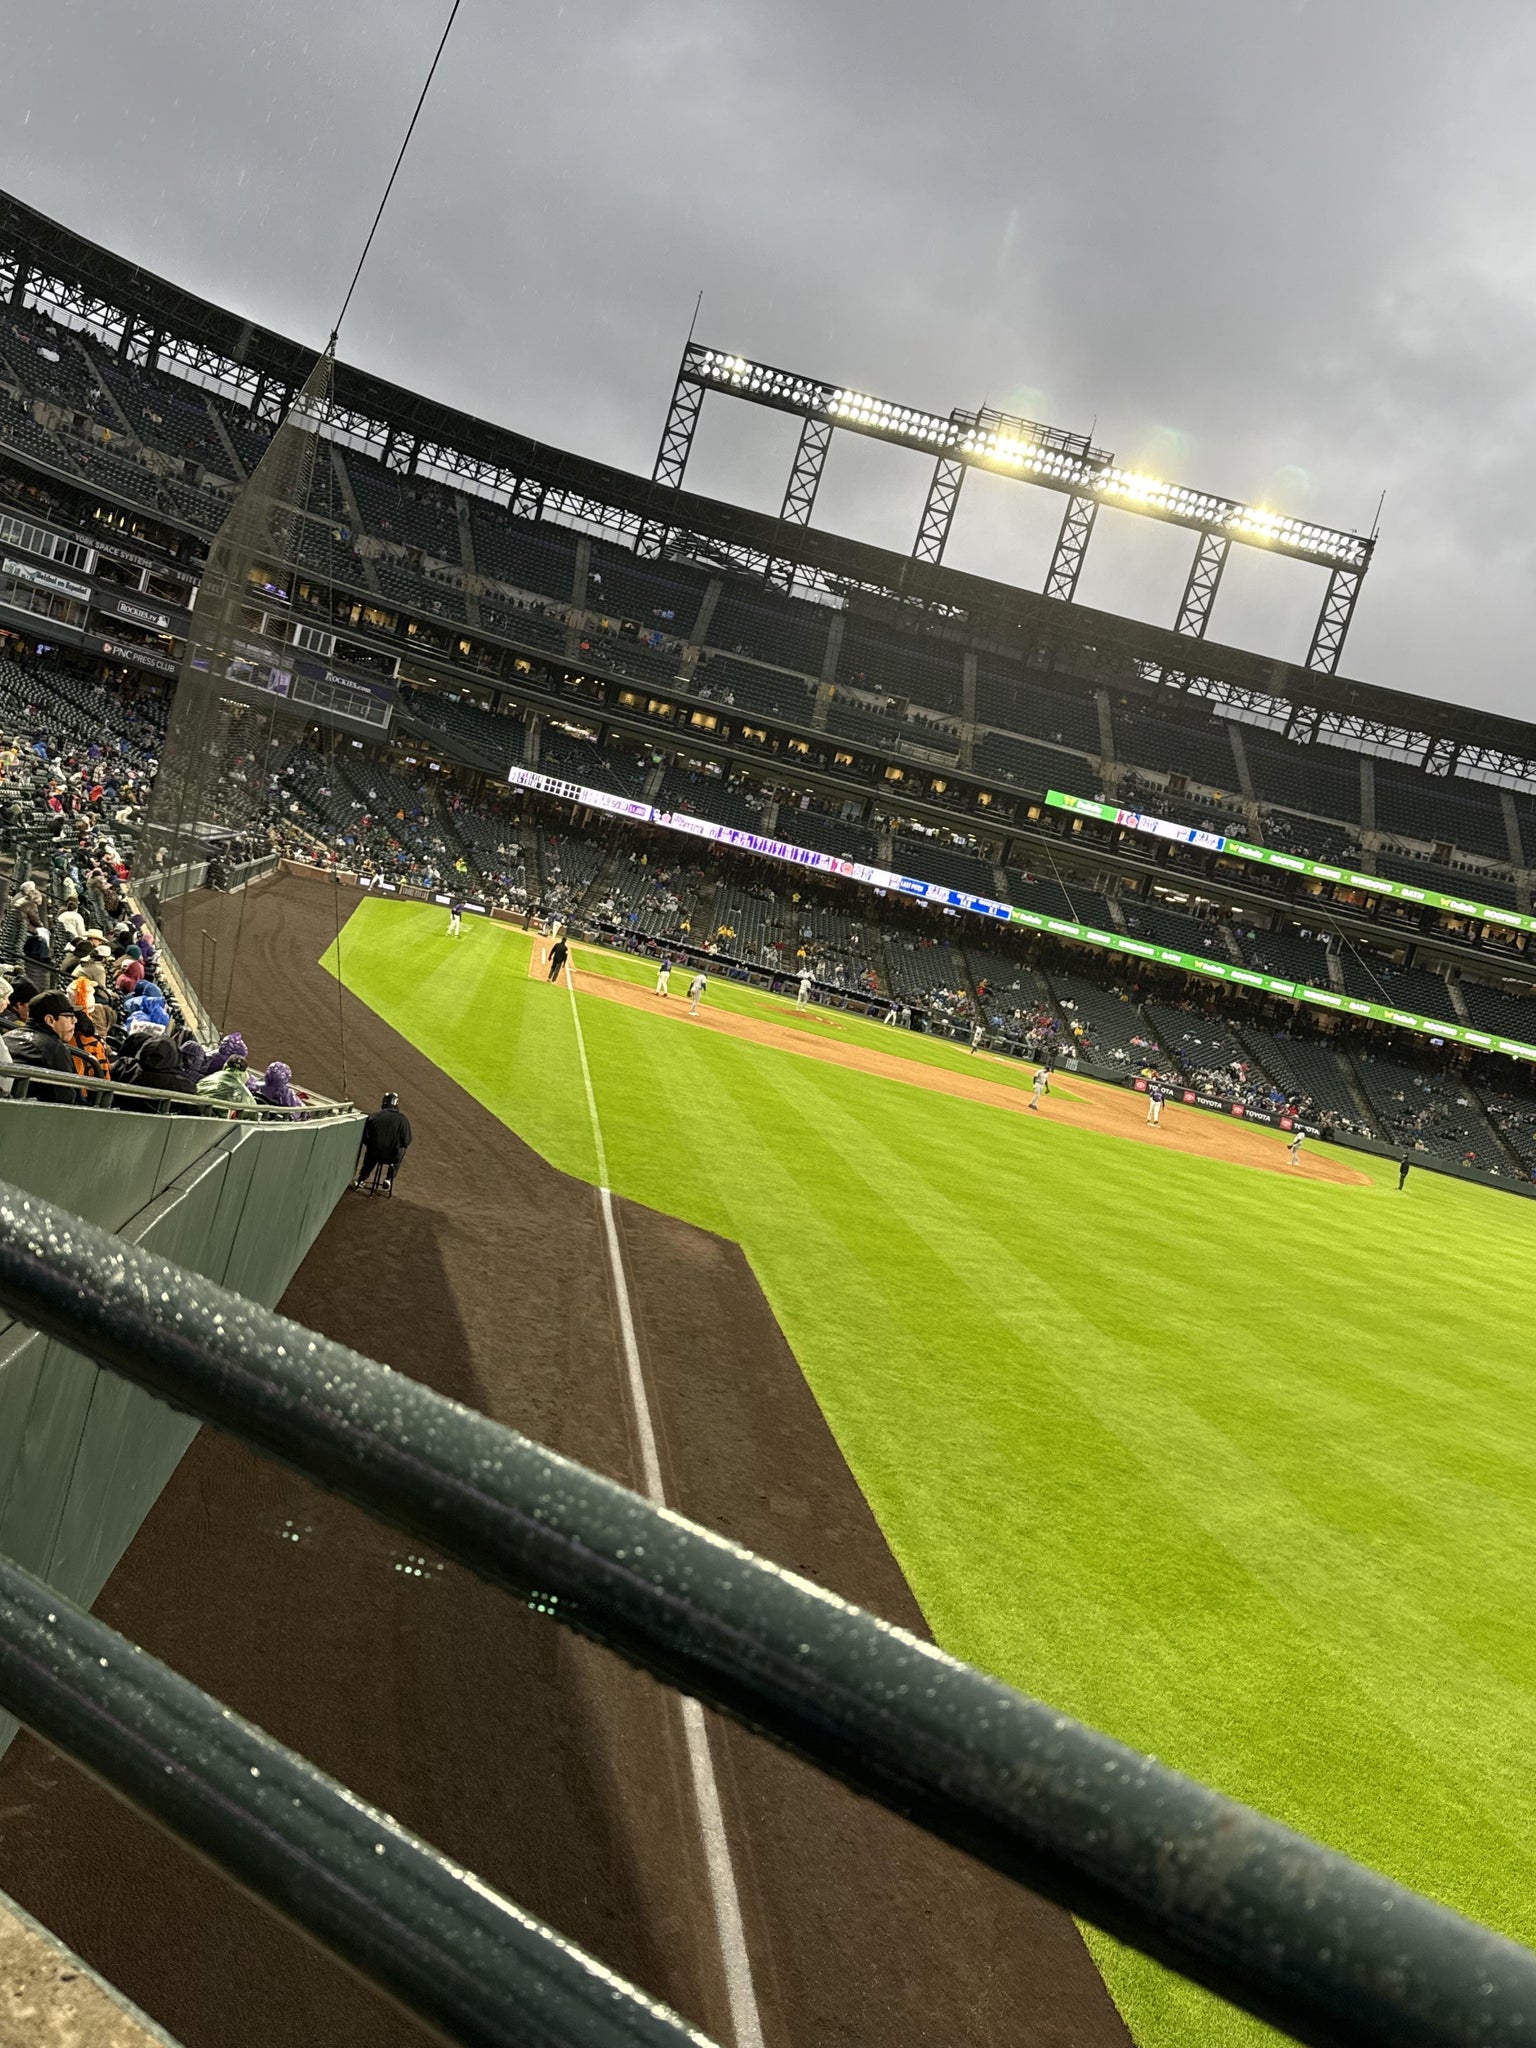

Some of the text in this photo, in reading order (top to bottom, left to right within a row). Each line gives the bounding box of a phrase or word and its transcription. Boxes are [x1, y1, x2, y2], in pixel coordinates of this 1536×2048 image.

[74, 532, 153, 569] YORK SPACE SYSTEMS
[176, 572, 197, 586] SUITE
[113, 645, 176, 673] PNC PRESS CLUB
[1269, 854, 1305, 870] ROOFING
[1313, 866, 1342, 880] SIDING
[1350, 875, 1393, 892] WINDOWS
[1401, 888, 1425, 901] BATH
[1483, 909, 1521, 925] ROOFING
[1047, 920, 1079, 935] ROOFING
[1118, 940, 1154, 956] WINDOWS
[1161, 951, 1182, 963] BATH
[1231, 971, 1262, 985] ROOFING
[1303, 990, 1342, 1005] WINDOWS
[1349, 1001, 1370, 1013] BATH
[1423, 1021, 1458, 1036] ROOFING
[1148, 1084, 1174, 1096] TOOTA
[1197, 1097, 1222, 1109] TOYOTA
[1245, 1110, 1271, 1122] TOYOTA
